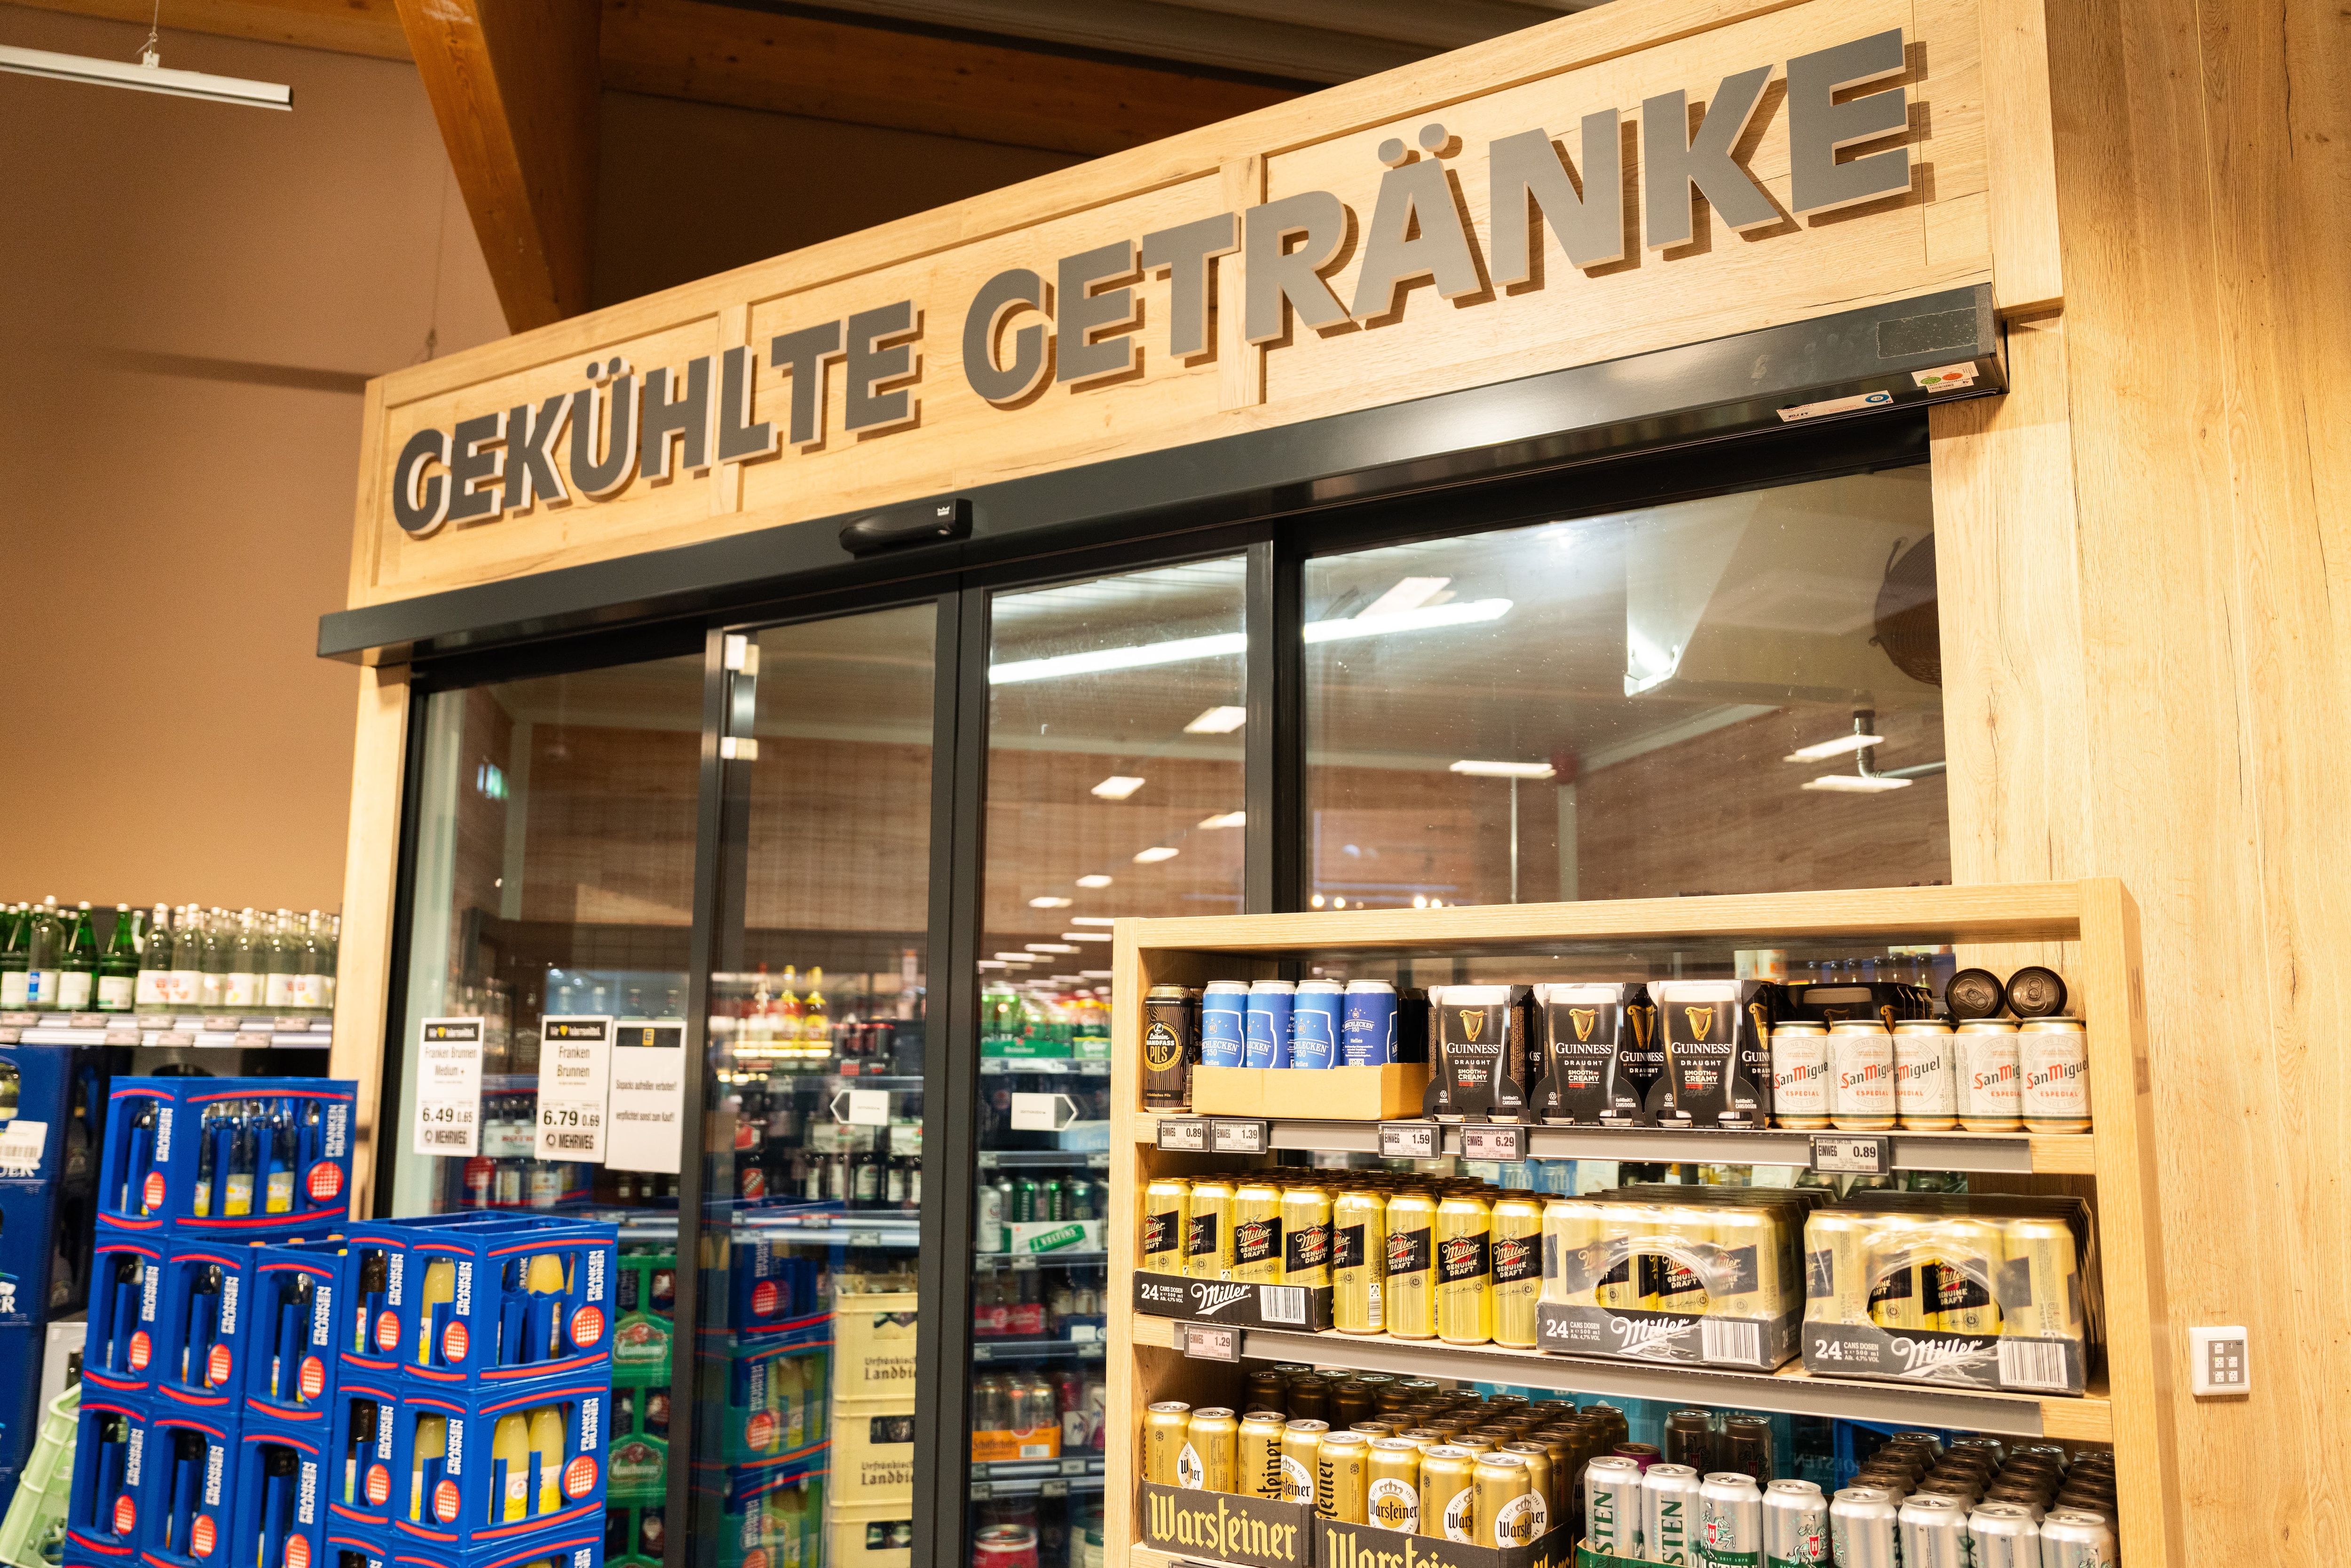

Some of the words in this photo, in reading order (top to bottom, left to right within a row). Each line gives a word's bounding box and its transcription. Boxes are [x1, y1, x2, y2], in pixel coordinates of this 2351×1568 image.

[393, 299, 917, 535] GEKÜHLTE
[963, 27, 1914, 404] GETRÄNKE
[426, 1047, 449, 1058] Franken
[451, 1047, 477, 1058] Brunnen
[559, 1046, 590, 1058] Franken
[1446, 1042, 1499, 1054] GUINNESS
[1555, 1042, 1611, 1054] GUINNESS
[1671, 1042, 1730, 1054] GUINNESS
[1150, 1046, 1168, 1063] PILS
[1167, 1049, 1181, 1068] FRANKEN
[435, 1064, 459, 1076] Medium
[557, 1064, 590, 1077] Brunnen
[423, 1108, 453, 1122] 6.49
[544, 1110, 578, 1126] 6.79
[582, 1115, 600, 1127] 0.69
[435, 1130, 467, 1144] MEHRWEG
[1163, 1127, 1176, 1136] EINWEG
[1186, 1128, 1201, 1137] 0.89
[1217, 1128, 1231, 1138] EINWEG
[1242, 1129, 1257, 1139] 1.39
[558, 1134, 594, 1149] MEHRWEG
[1385, 1133, 1399, 1143] EINWEG
[1412, 1134, 1430, 1144] 1.59
[1467, 1135, 1483, 1146] EINWEG
[1496, 1136, 1514, 1147] 6.29
[1818, 1145, 1837, 1156] EINWEG
[1853, 1146, 1876, 1157] 0.89
[1237, 1228, 1272, 1246] Miller
[1295, 1232, 1330, 1252] Miller
[1240, 1243, 1269, 1253] GENUINE
[1243, 1249, 1266, 1259] DRAFT
[1301, 1246, 1328, 1259] GENUINE
[1387, 1239, 1418, 1258] Miller
[1442, 1244, 1480, 1264] Miller
[1305, 1253, 1326, 1264] DRAFT
[1389, 1255, 1415, 1265] GENUINE
[1493, 1245, 1530, 1265] Miller
[1390, 1262, 1411, 1270] DRAFT
[1446, 1259, 1477, 1271] GENUINE
[1450, 1266, 1473, 1276] DRAFT
[1497, 1261, 1527, 1273] GENUINE
[587, 1251, 596, 1301] FRANKEN
[1499, 1269, 1523, 1278] DRAFT
[1671, 1278, 1697, 1289] DRAFT
[1141, 1284, 1159, 1300] 24
[1938, 1288, 1968, 1299] GENUINE
[1191, 1283, 1251, 1315] Miller
[1941, 1296, 1964, 1305] DRAFT
[1546, 1319, 1569, 1339] 24
[1610, 1316, 1690, 1353] Miller
[1190, 1334, 1203, 1344] EINWEG
[1215, 1336, 1230, 1347] 1.29
[1815, 1339, 1842, 1360] 24
[1891, 1337, 1983, 1377] Miller
[1297, 1469, 1305, 1480] 1753
[1750, 1465, 1756, 1474] H
[1405, 1490, 1413, 1500] 1753
[1531, 1496, 1540, 1505] 1753
[1370, 1498, 1418, 1521] Warsteiner
[1453, 1500, 1461, 1510] SEIT
[1504, 1509, 1513, 1519] SEIT
[1148, 1491, 1298, 1562] Warsteiner
[1709, 1528, 1714, 1540] H
[1811, 1540, 1818, 1552] H
